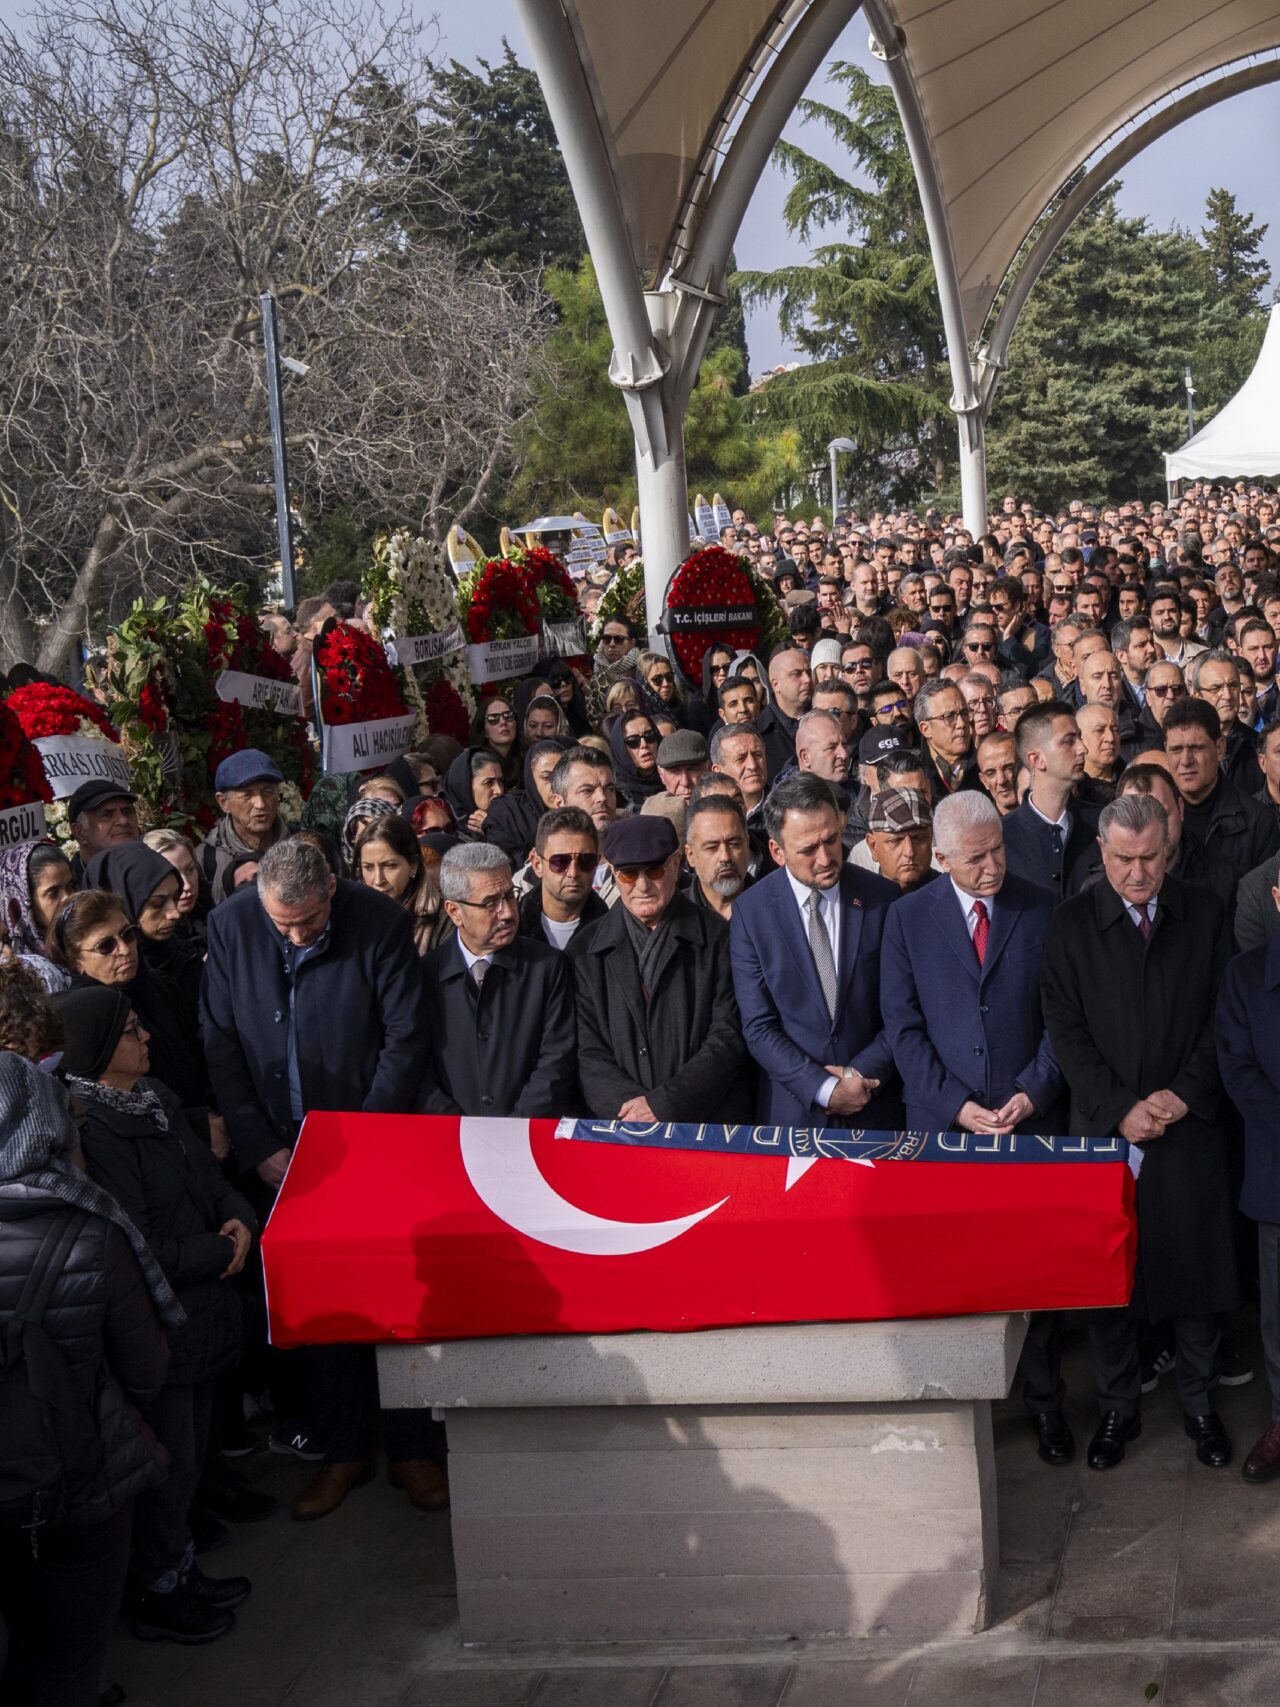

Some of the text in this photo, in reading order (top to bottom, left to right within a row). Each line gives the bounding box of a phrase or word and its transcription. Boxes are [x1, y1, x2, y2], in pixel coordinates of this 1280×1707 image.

[674, 611, 753, 624] T.C. İÇİŞLERİ BAKANI
[252, 679, 267, 702] ARİF
[353, 727, 371, 758] ALİ
[878, 738, 900, 749] ege
